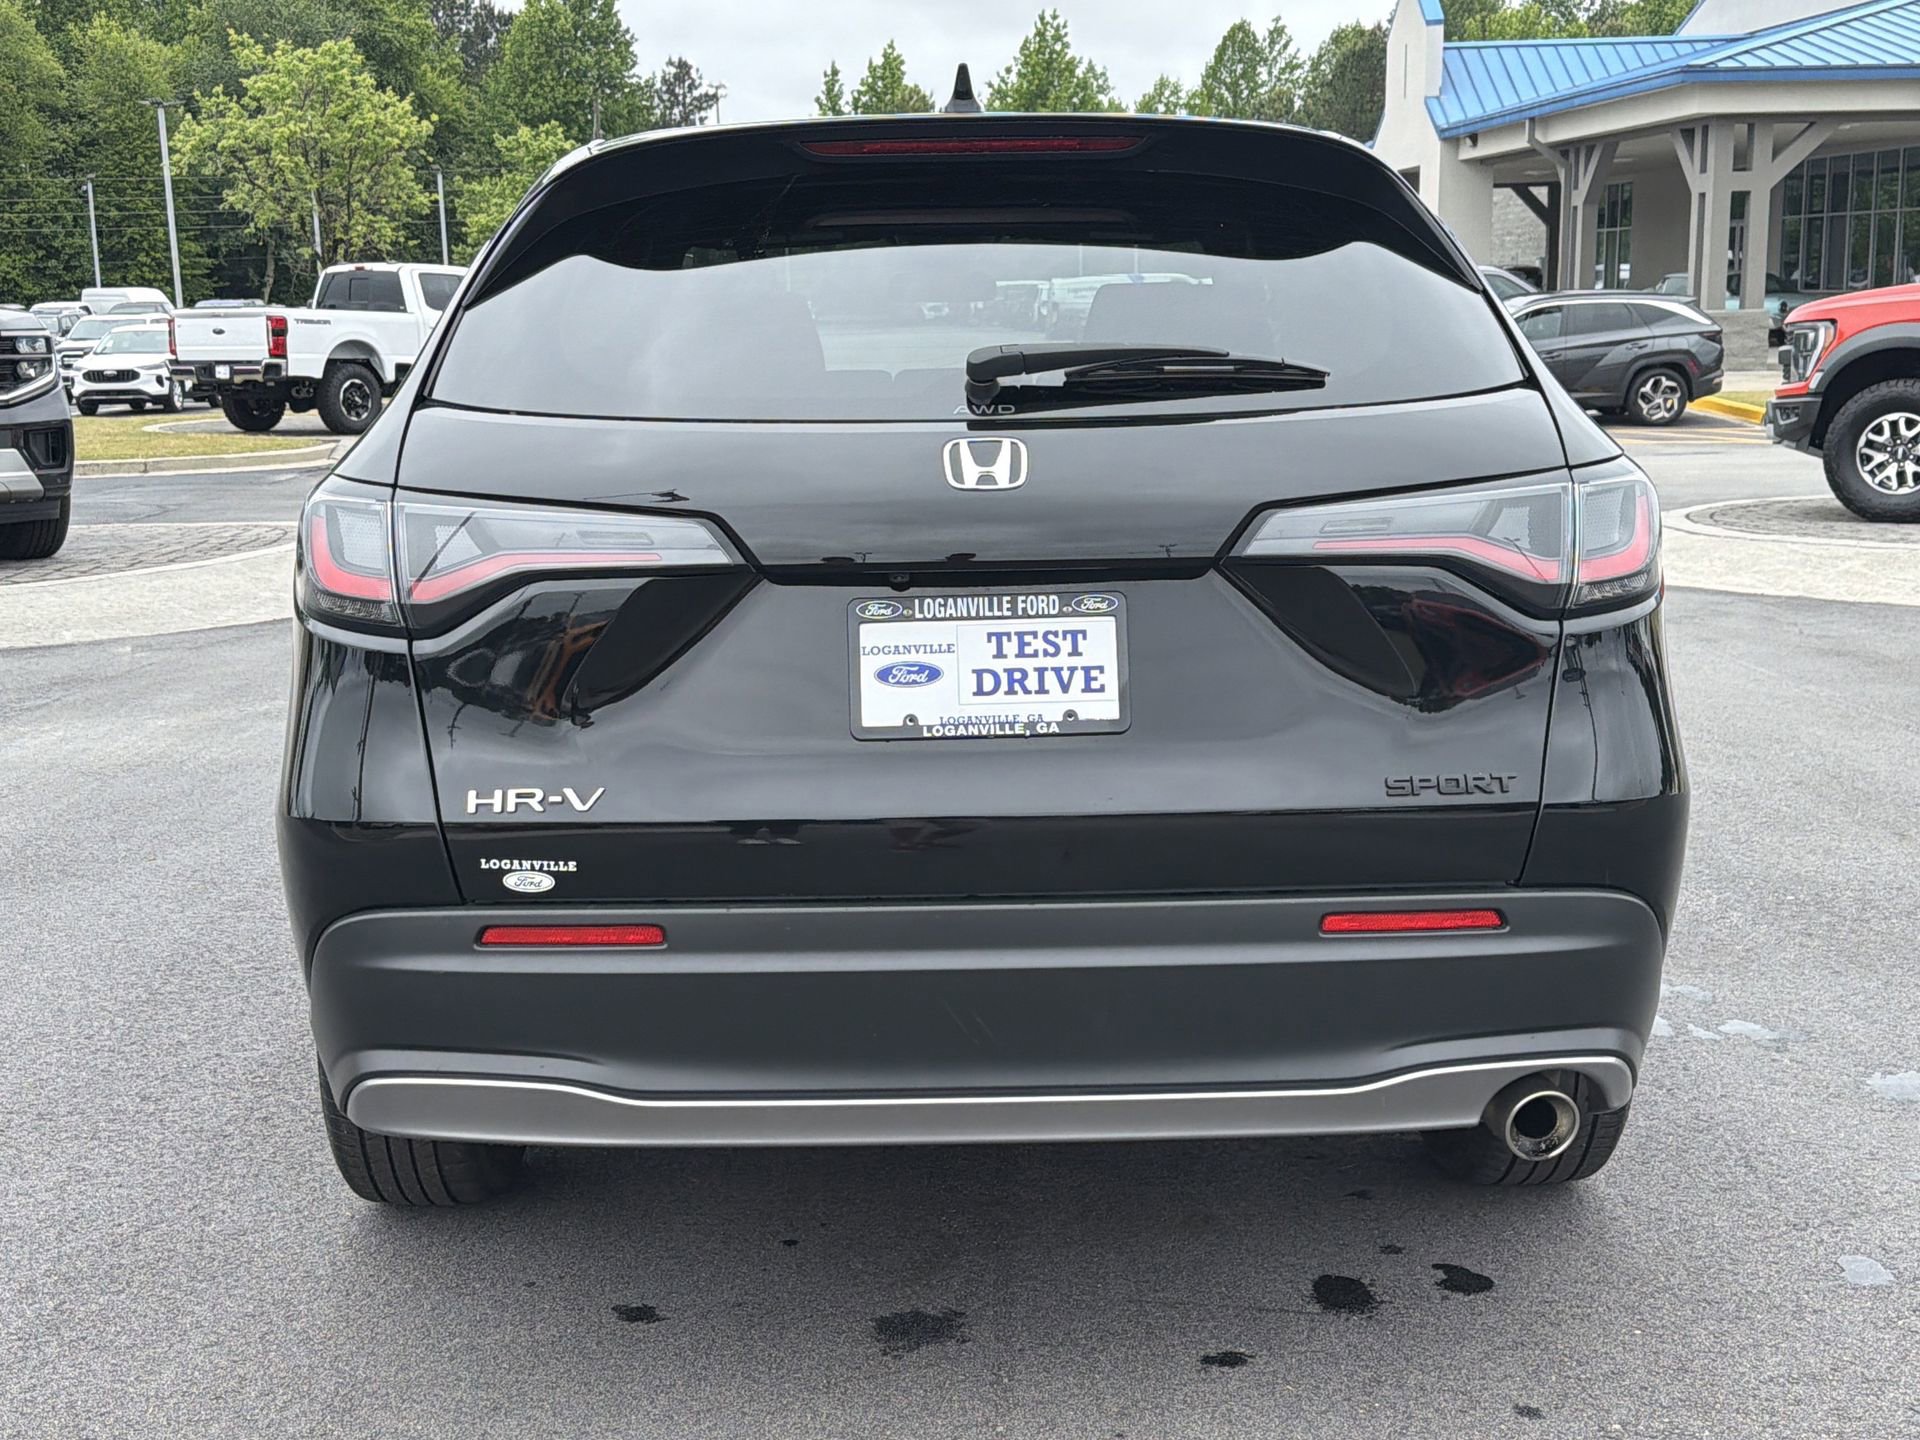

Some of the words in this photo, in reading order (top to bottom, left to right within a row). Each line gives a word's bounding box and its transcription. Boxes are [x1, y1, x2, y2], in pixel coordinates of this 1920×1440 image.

[953, 405, 1015, 414] AWD
[865, 603, 893, 616] Ford
[914, 596, 1012, 619] LOGANVILLE
[1017, 594, 1060, 616] FORD
[1080, 597, 1109, 610] Ford
[861, 643, 956, 656] LOGANVILLE
[986, 629, 1088, 660] TEST
[888, 665, 930, 684] Ford
[971, 665, 1106, 697] DRIVE
[1027, 713, 1044, 723] GA
[922, 723, 1031, 737] LOGANVILLE,
[1036, 722, 1060, 735] GA
[1385, 773, 1517, 797] SPORT
[466, 787, 605, 814] HR-V
[480, 858, 578, 872] LOGANVILLE
[514, 876, 544, 888] Ford
